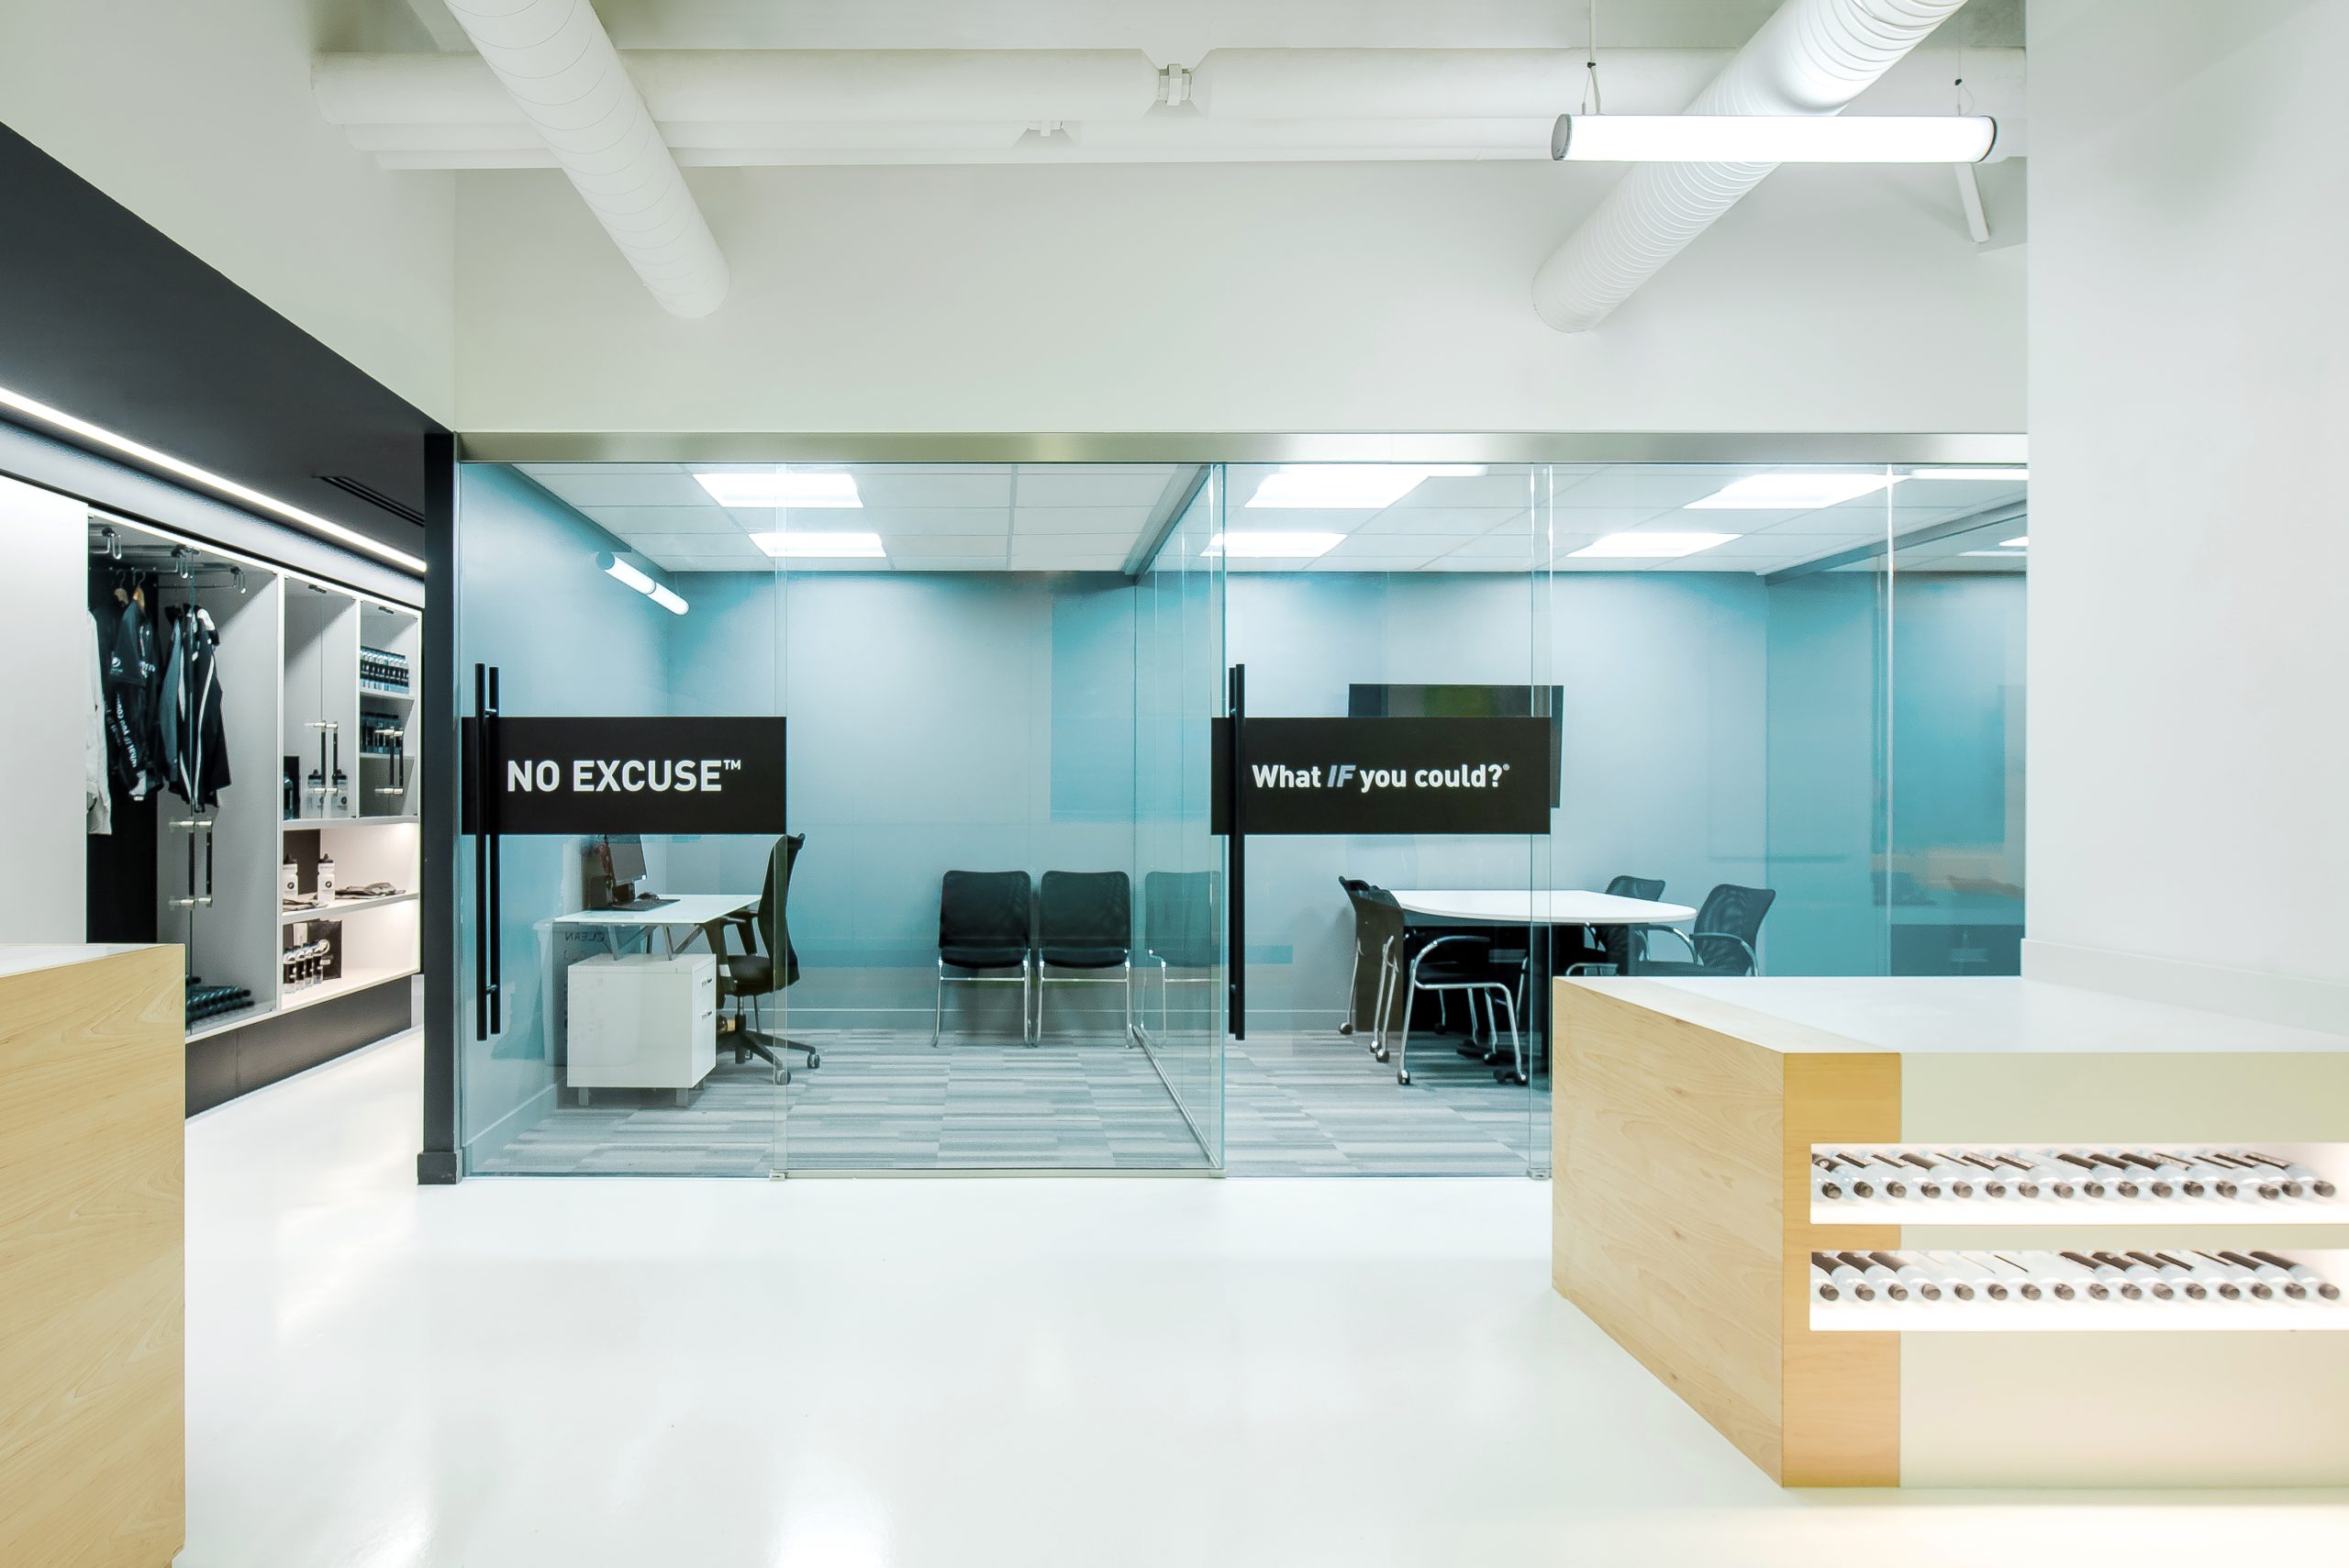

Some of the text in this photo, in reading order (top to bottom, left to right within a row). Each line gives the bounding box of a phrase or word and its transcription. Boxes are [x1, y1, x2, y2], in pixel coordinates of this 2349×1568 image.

[507, 760, 561, 792] NO
[1252, 764, 1322, 788] What
[1327, 764, 1357, 788] IF
[1359, 769, 1407, 794] you
